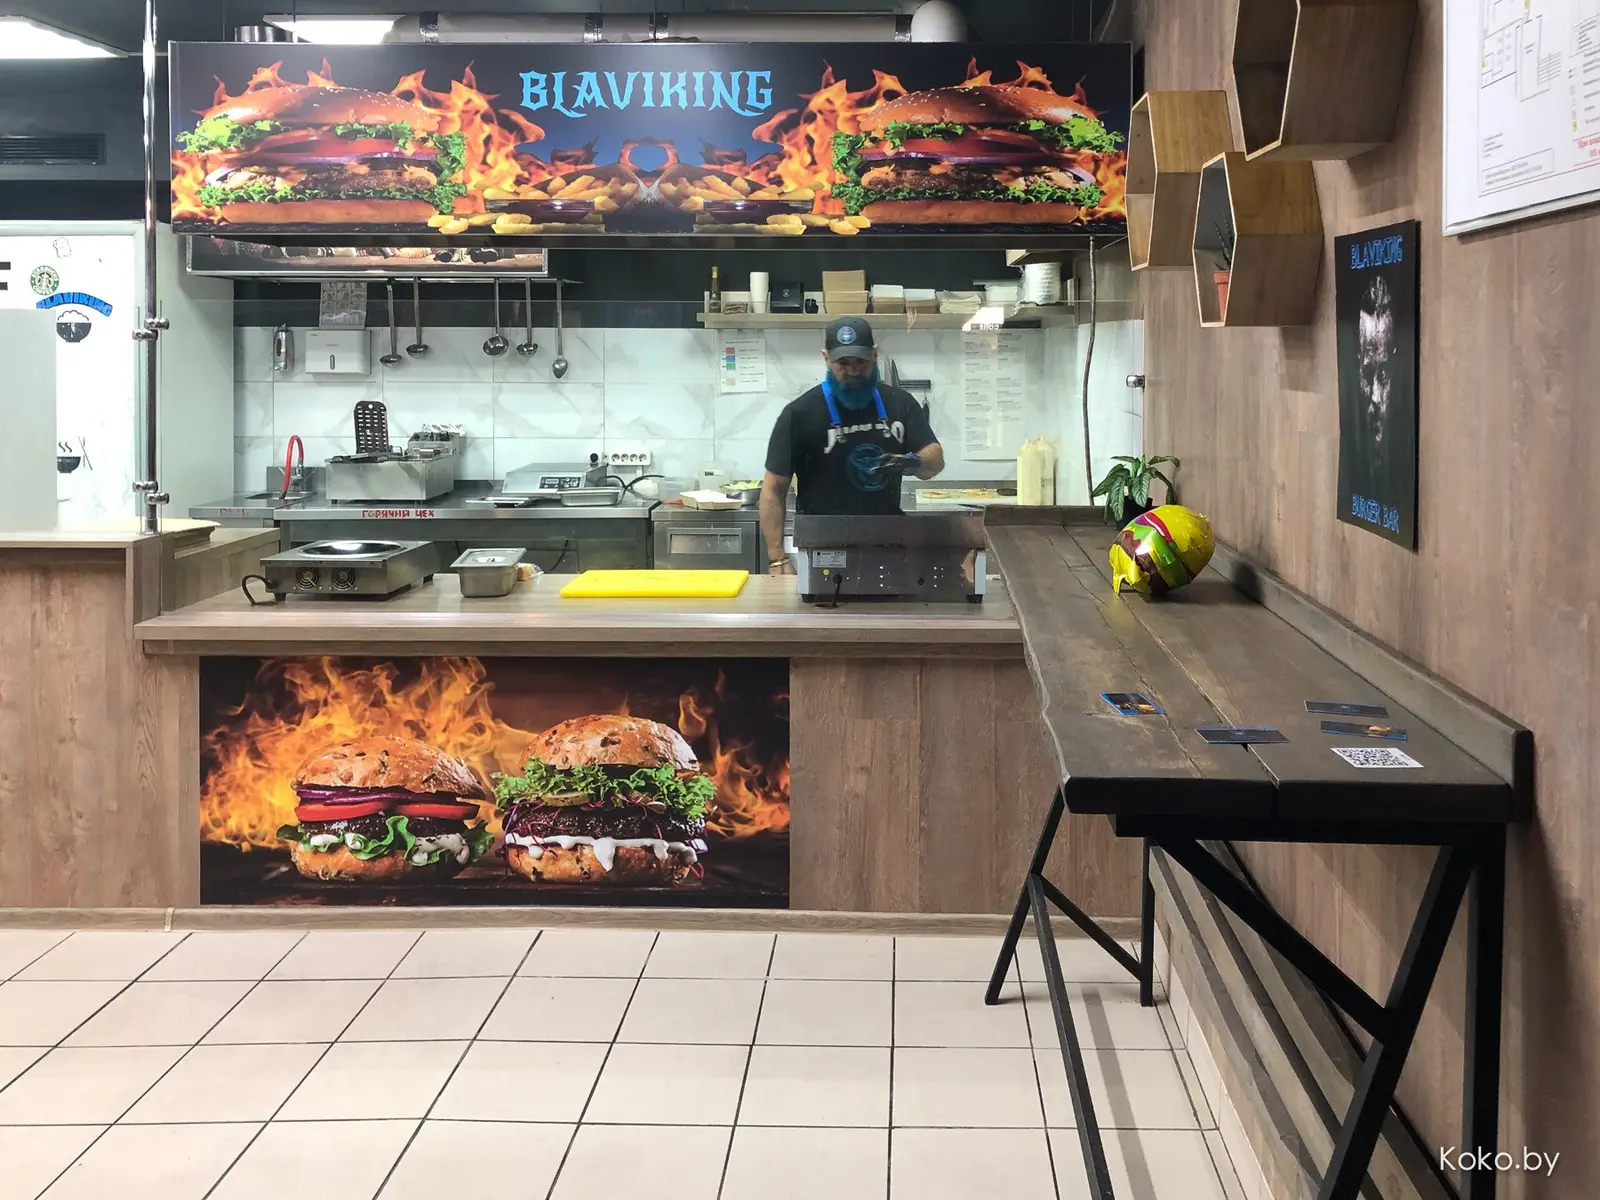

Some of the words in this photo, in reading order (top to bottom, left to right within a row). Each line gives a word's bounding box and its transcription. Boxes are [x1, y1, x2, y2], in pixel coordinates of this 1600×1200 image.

[519, 69, 773, 118] BLAVIKING
[1351, 235, 1403, 269] BLAVIKING
[415, 509, 435, 519] ЦЕХ
[1352, 494, 1380, 525] BURGER
[1383, 504, 1399, 534] BAR
